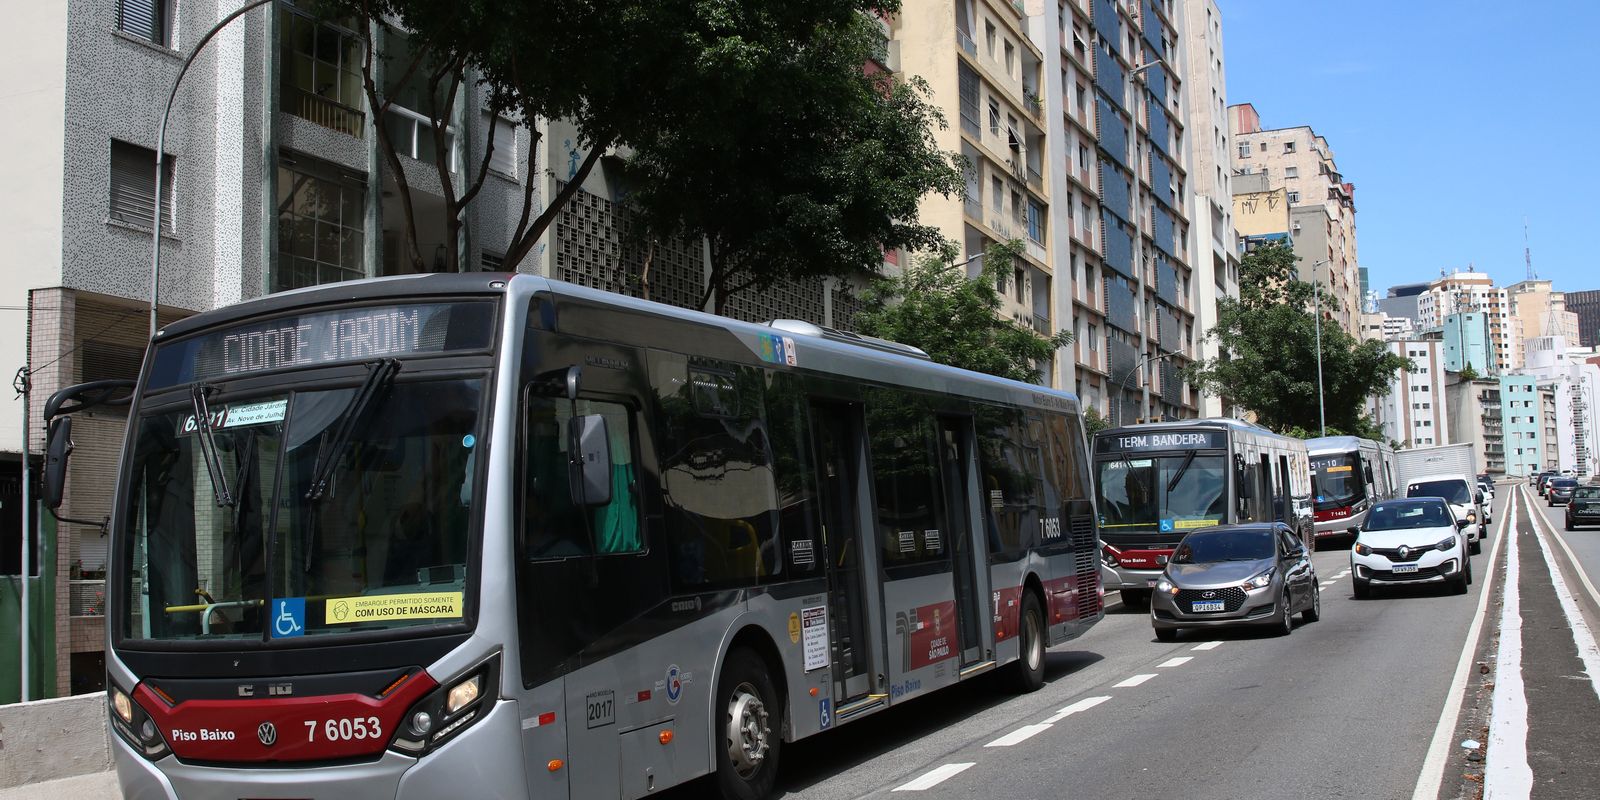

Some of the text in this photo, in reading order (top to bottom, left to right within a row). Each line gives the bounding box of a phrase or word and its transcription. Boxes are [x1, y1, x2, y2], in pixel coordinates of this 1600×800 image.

[224, 310, 418, 373] CIDADE JARDIM
[241, 405, 263, 413] Cidade
[1118, 433, 1206, 448] TERM. BANDEIRA
[1039, 517, 1060, 539] 7 6053
[355, 600, 388, 608] EMBARQUE
[424, 596, 454, 604] SOMENTE
[355, 604, 454, 617] COM USO DE MÁSCARA
[891, 679, 921, 699] Piso Baixo
[588, 700, 612, 720] 2017
[172, 729, 235, 741] Piso Baixo
[304, 716, 382, 742] 7 6053
